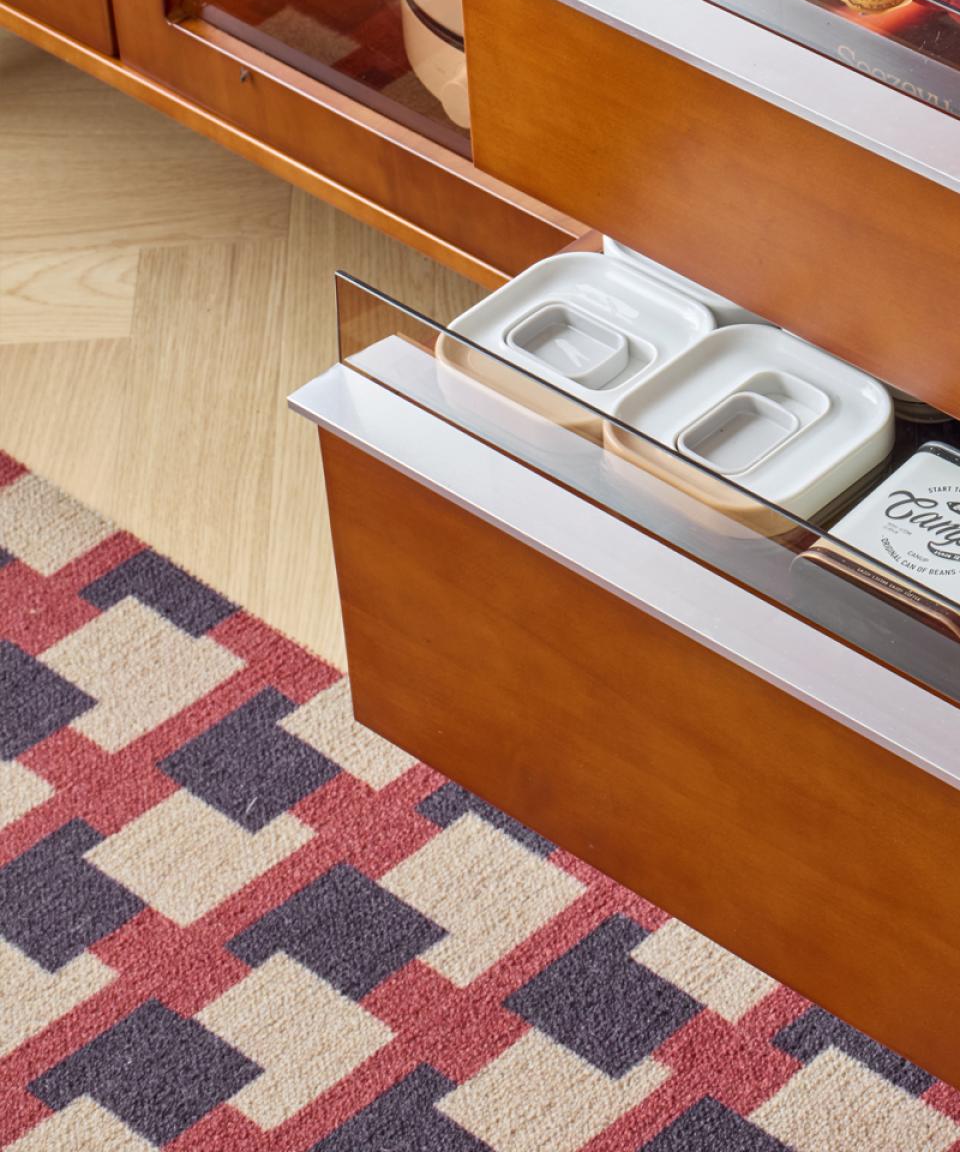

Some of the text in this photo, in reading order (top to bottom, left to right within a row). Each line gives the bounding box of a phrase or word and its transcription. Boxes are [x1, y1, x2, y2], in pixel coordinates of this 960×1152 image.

[928, 485, 952, 494] START
[881, 536, 902, 563] ORIGINAL
[900, 559, 916, 570] CAN
